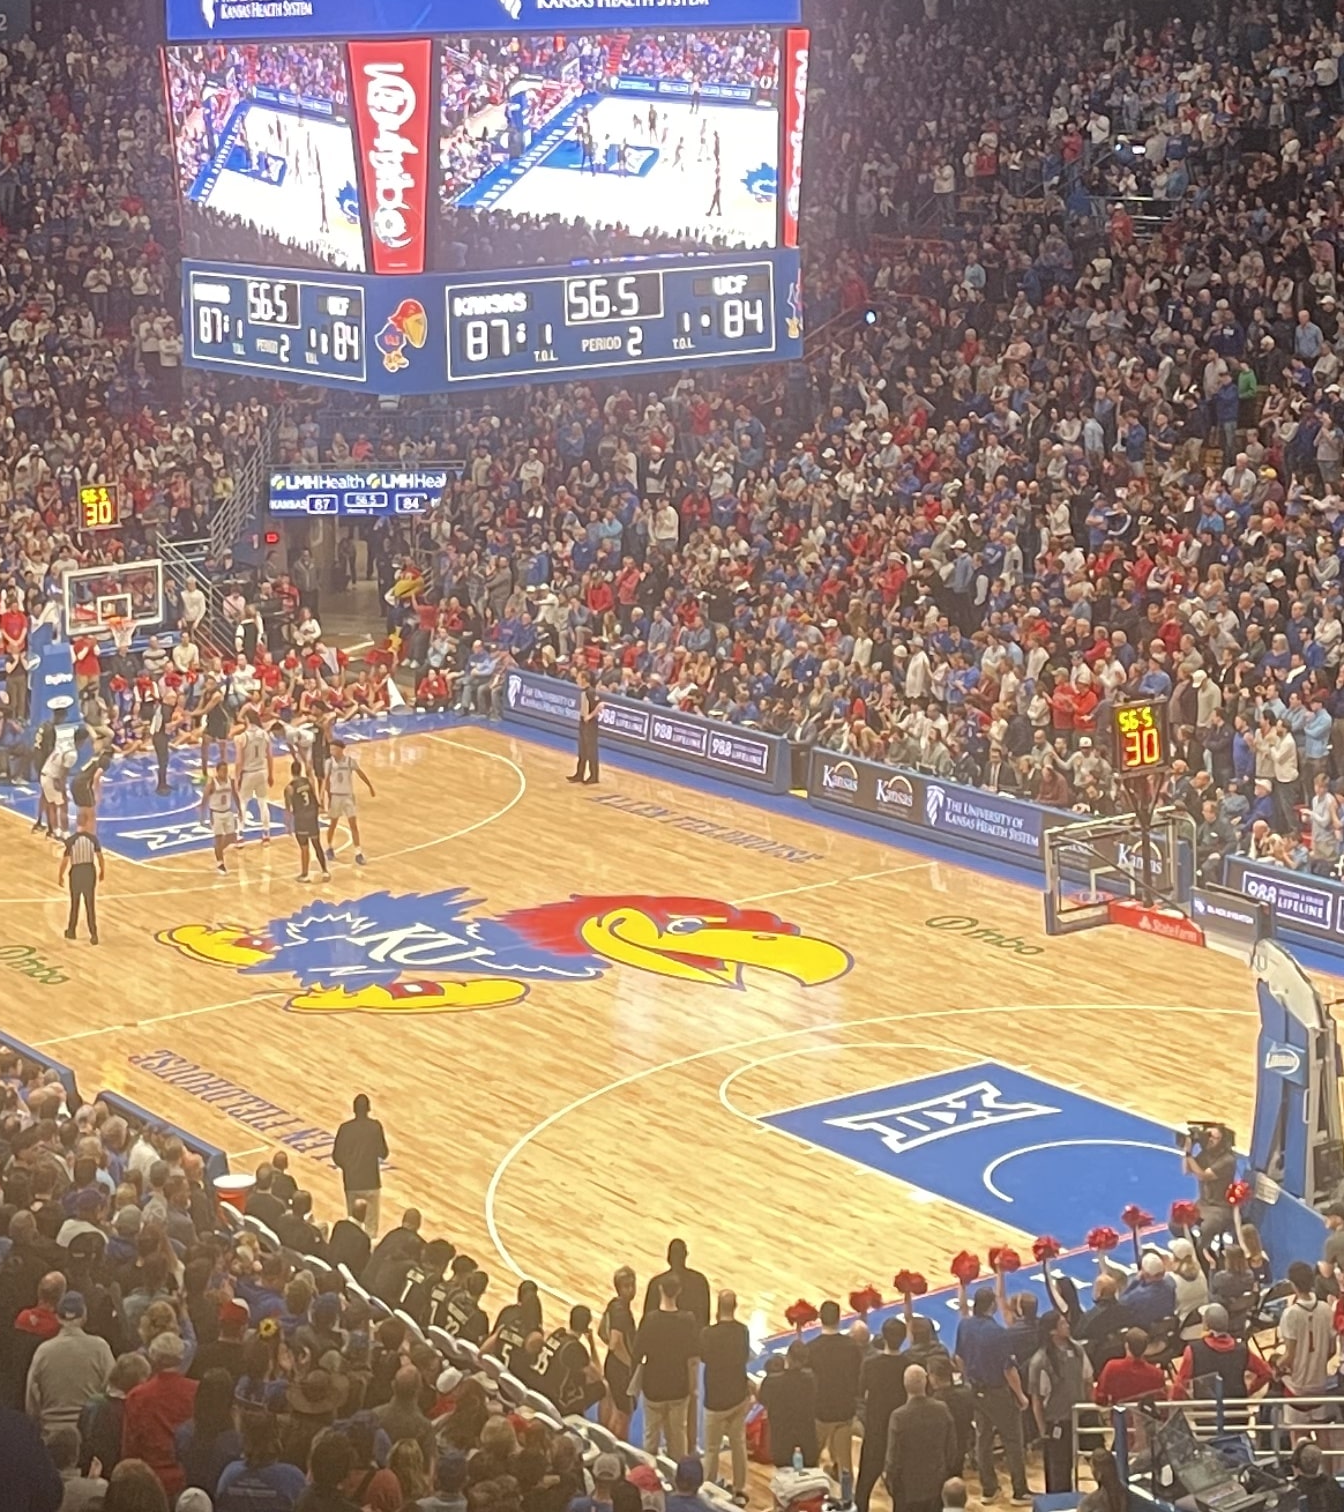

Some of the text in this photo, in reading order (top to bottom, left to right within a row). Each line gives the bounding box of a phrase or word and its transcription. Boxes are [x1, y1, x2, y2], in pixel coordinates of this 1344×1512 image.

[220, 0, 313, 20] KANSAS HEALTH SYSTEM
[248, 281, 288, 323] 56.5
[453, 275, 749, 320] KANSAS 56.5 UCF
[199, 306, 222, 344] 87
[332, 321, 359, 361] 84
[466, 299, 763, 361] 87 1 1 84
[581, 326, 644, 357] PERIOD 2
[279, 334, 291, 363] 2
[285, 474, 365, 489] LMH Health
[381, 473, 447, 488] LMH Heal
[86, 501, 112, 526] 30
[314, 498, 331, 510] 87
[402, 498, 419, 509] 84
[654, 722, 673, 741] 988
[712, 738, 732, 757] 988
[1125, 729, 1161, 768] 30
[822, 764, 858, 792] Kansas
[875, 778, 913, 807] Kansas
[301, 790, 310, 806] 3
[589, 793, 673, 824] ALLEN
[945, 796, 1024, 829] THE UNIVERSITY OF
[944, 811, 976, 831] KANSAS
[976, 821, 1008, 839] HEALTH
[1008, 829, 1039, 848] SYSTEM
[1277, 898, 1324, 919] LIFELINE
[357, 923, 488, 964] KU
[127, 1049, 292, 1133] FIELDHOUSE
